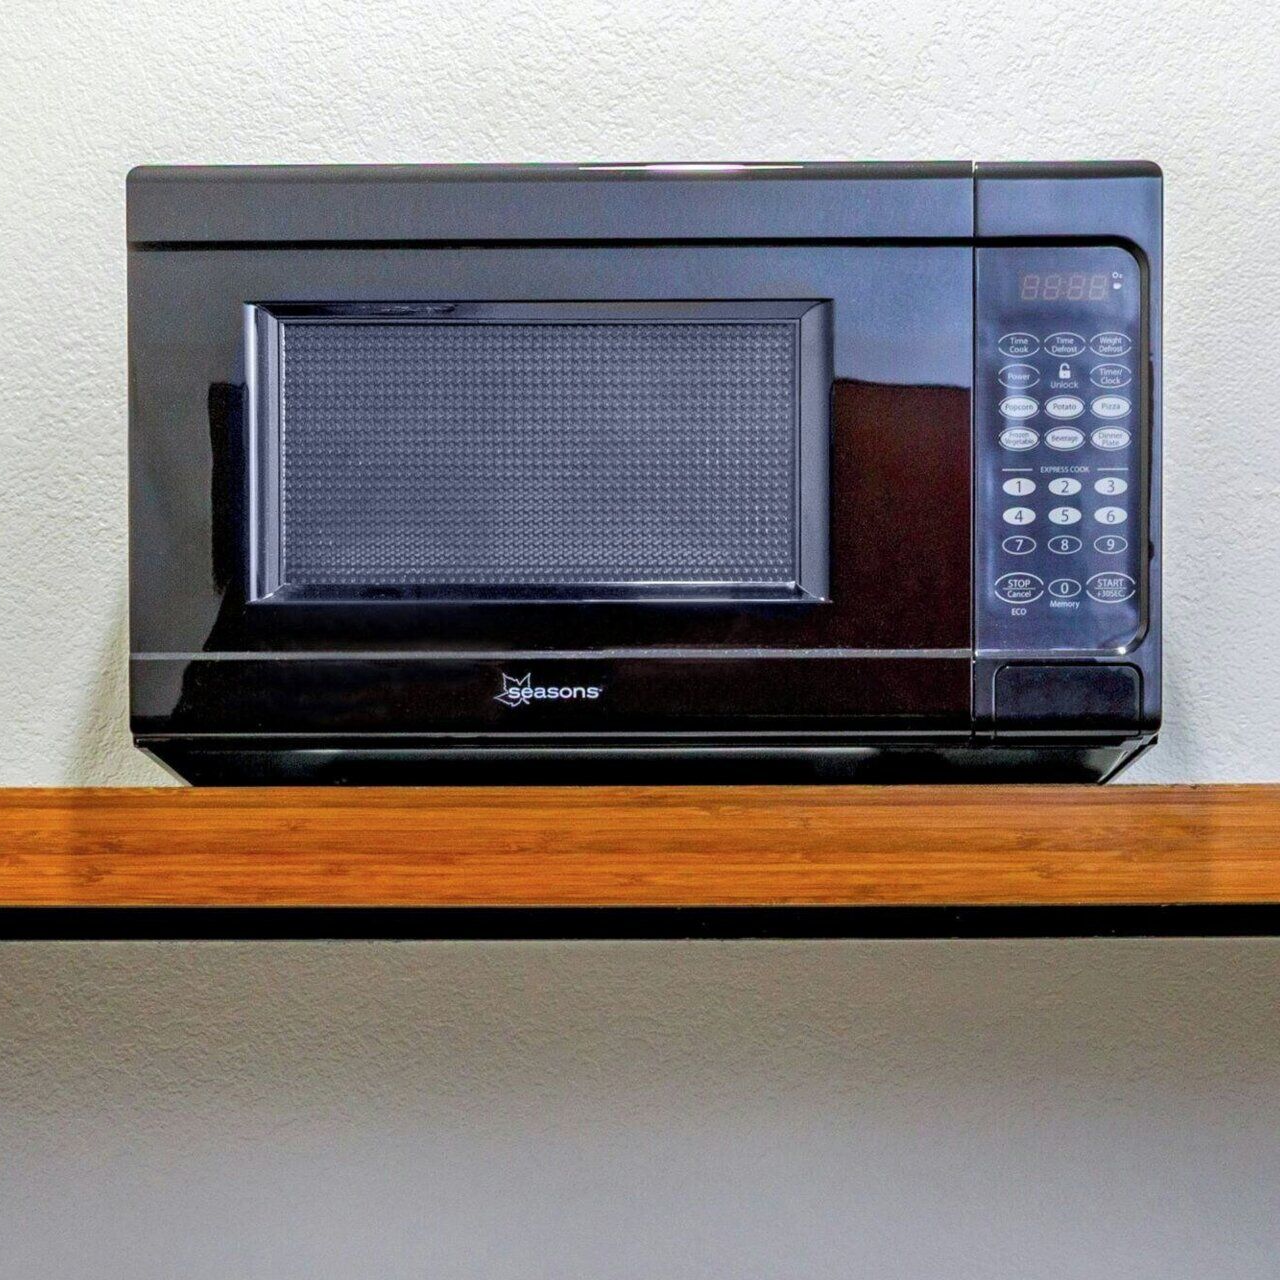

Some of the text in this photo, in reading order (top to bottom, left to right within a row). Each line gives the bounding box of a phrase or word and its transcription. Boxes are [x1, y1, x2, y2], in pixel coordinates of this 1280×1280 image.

[1056, 336, 1074, 344] Time
[1100, 336, 1122, 346] Weight
[1051, 345, 1078, 353] Defrost
[1099, 345, 1123, 353] Defrost
[1007, 372, 1030, 380] Power
[1100, 376, 1121, 384] Clock
[1050, 381, 1079, 389] Unlock
[1005, 404, 1034, 412] Popcorn
[1101, 402, 1121, 410] Pizza
[1040, 465, 1091, 474] EXPRESS COOK
[1016, 480, 1021, 493] 1
[1060, 480, 1069, 493] 2
[1107, 480, 1115, 493] 3
[1014, 510, 1023, 523] 4
[1060, 509, 1069, 522] 5
[1106, 510, 1115, 522] 6
[1015, 539, 1024, 552] 7
[1060, 538, 1069, 551] 8
[1106, 538, 1115, 551] 9
[1007, 579, 1031, 588] STOP
[1097, 578, 1124, 587] START
[1060, 582, 1069, 594] 0
[1007, 590, 1031, 598] Cancel
[1049, 600, 1080, 609] Memory
[1011, 608, 1027, 616] ECO
[508, 686, 600, 699] seasons
